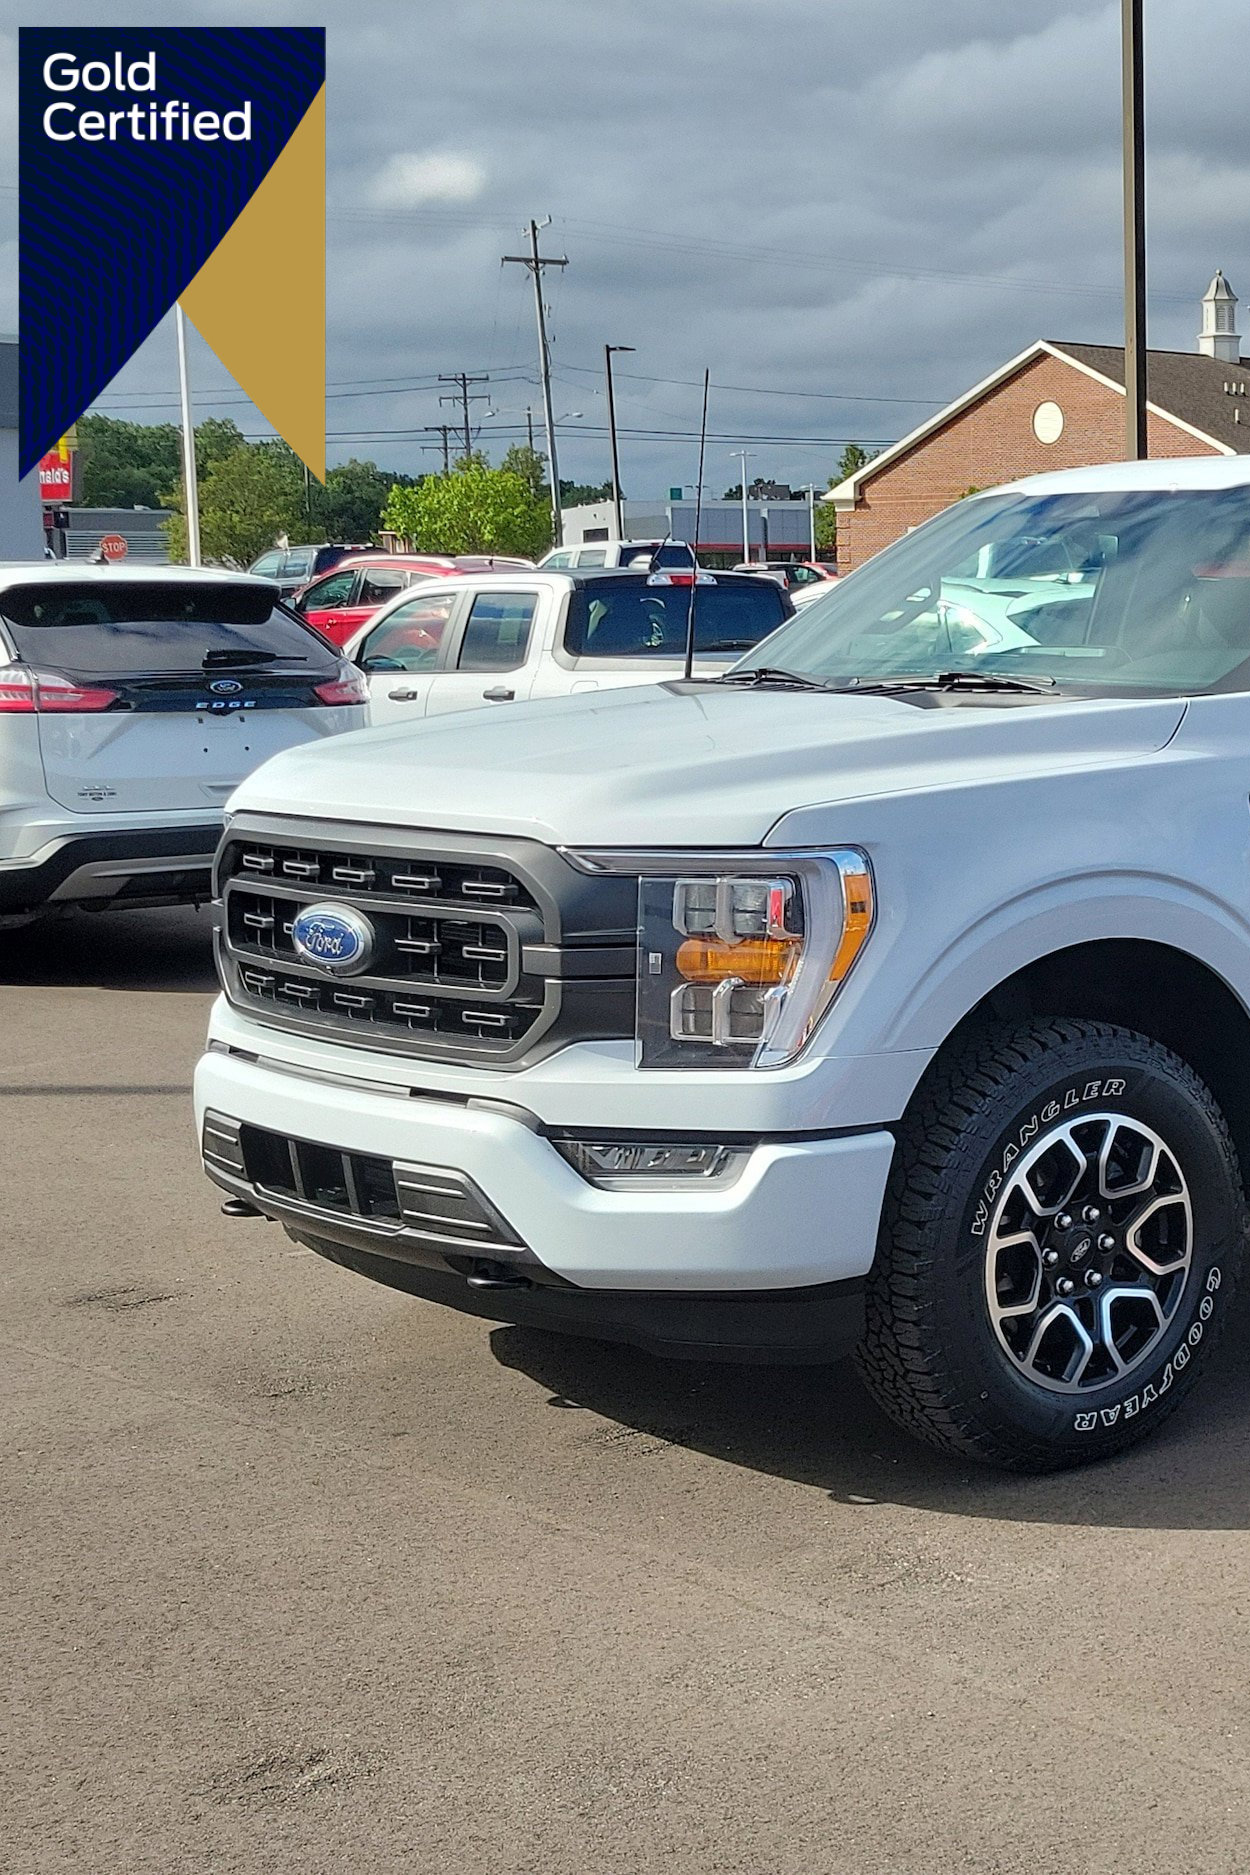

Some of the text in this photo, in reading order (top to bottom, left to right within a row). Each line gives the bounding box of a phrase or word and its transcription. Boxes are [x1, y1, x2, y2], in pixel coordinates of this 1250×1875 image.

[101, 542, 125, 552] STOP
[195, 700, 257, 709] EDGE
[305, 921, 344, 955] Ford
[970, 1077, 1127, 1236] WRANGLER
[1074, 1266, 1222, 1432] GOODYEAR
